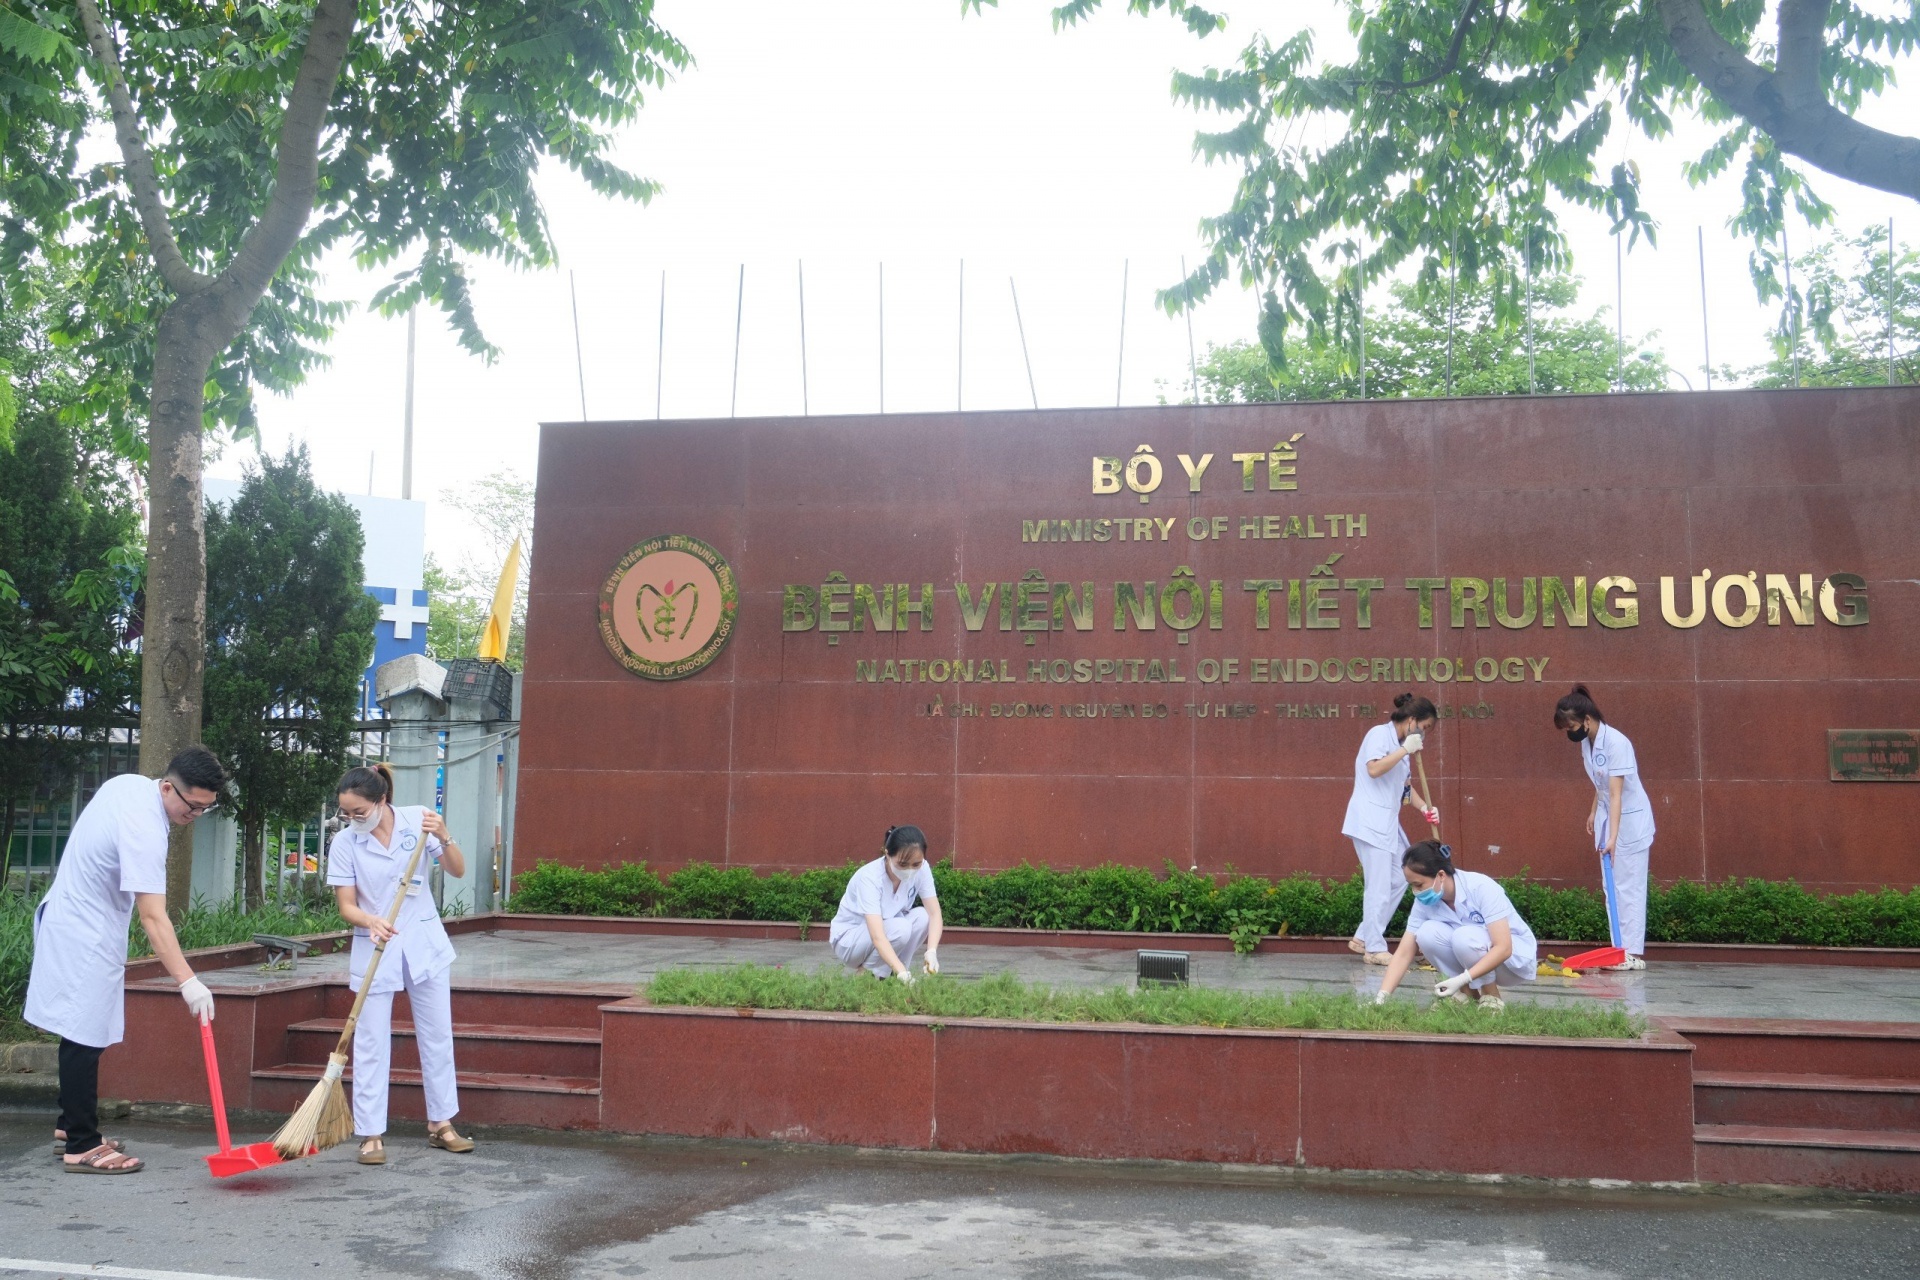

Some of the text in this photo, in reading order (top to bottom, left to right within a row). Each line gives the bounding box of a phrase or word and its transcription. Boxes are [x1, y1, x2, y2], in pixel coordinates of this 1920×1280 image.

[1092, 433, 1305, 503] BỘ Y TẾ
[1022, 514, 1368, 543] MINISTRY OF HEALTH
[687, 542, 717, 565] TRUNG
[782, 553, 1870, 646] BỆNH VIỆN NỘI TIẾT TRUNG ƯƠNG
[601, 618, 733, 676] NATIONAL HOSPITAL OF ENDOCRINOLOGY
[855, 656, 1550, 684] NATIONAL HOSPITAL OF ENDOCRINOLOGY
[1275, 703, 1340, 718] THANH
